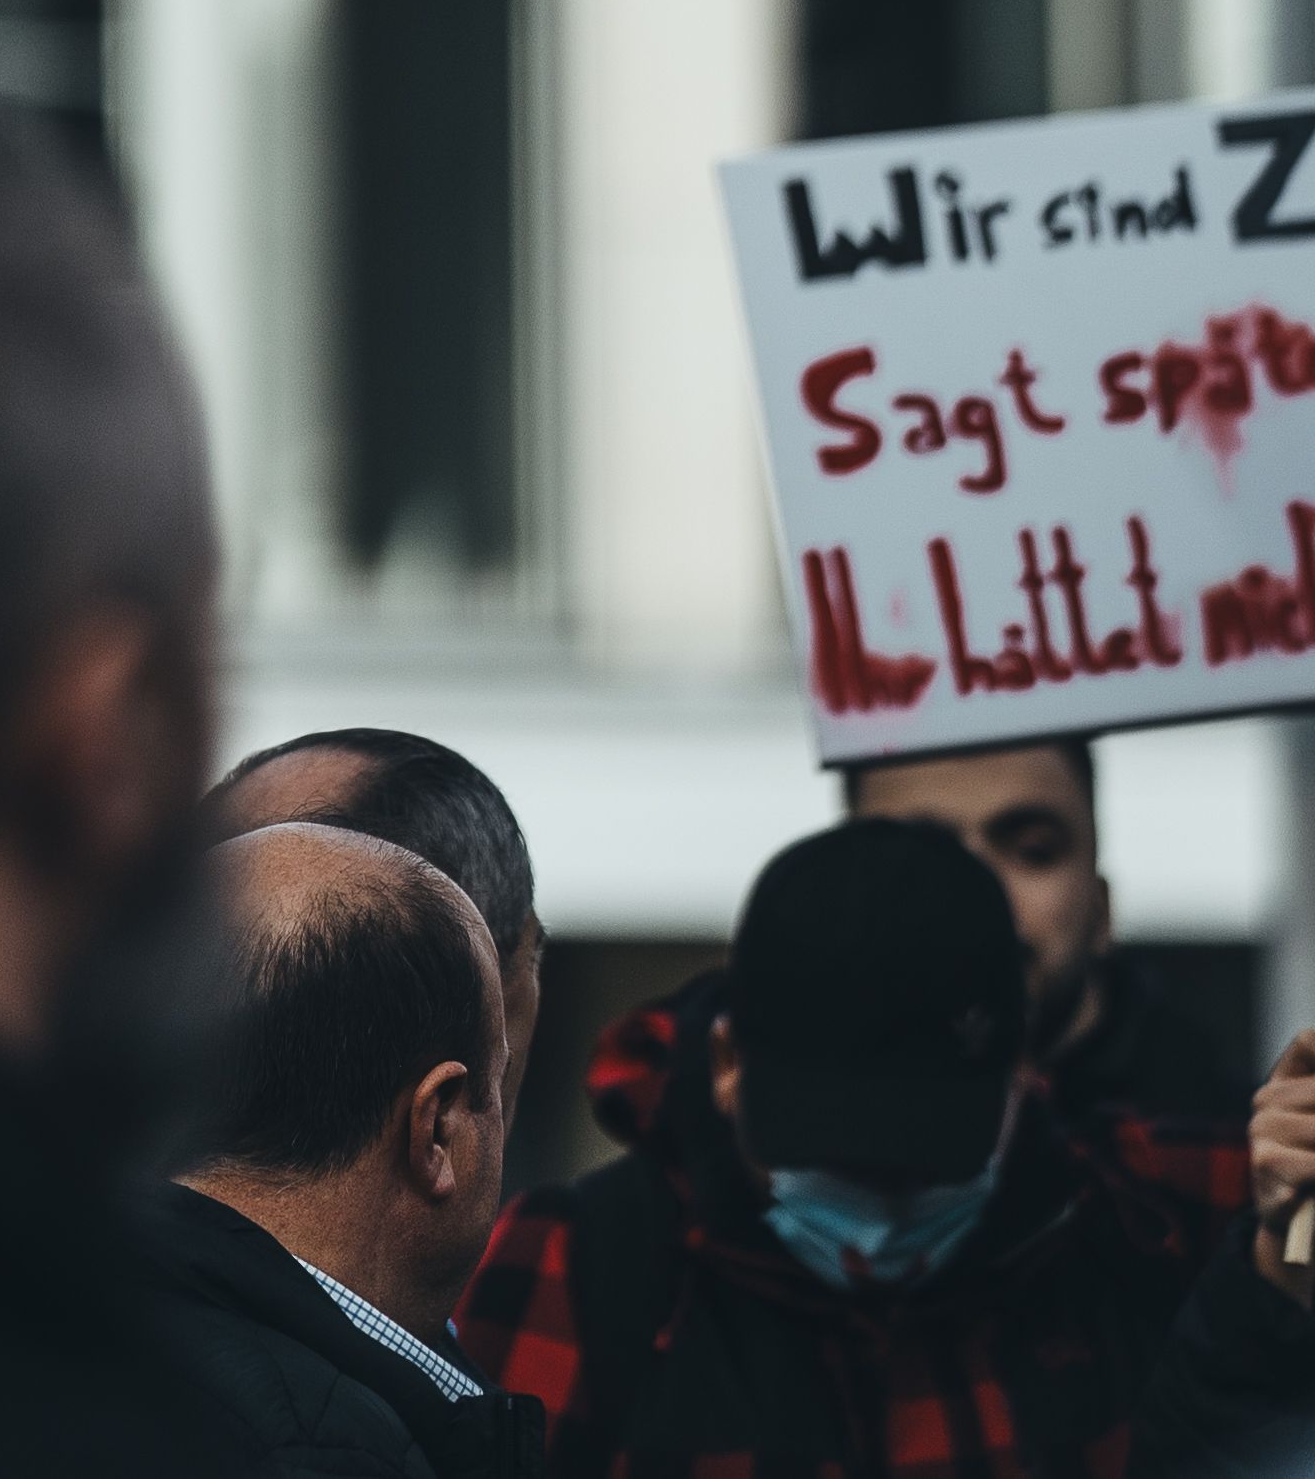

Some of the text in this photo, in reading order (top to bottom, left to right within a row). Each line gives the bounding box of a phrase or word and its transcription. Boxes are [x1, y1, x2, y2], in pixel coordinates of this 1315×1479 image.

[782, 163, 1011, 285] Wir
[1038, 163, 1198, 250] sind
[799, 344, 1067, 494] Sagt
